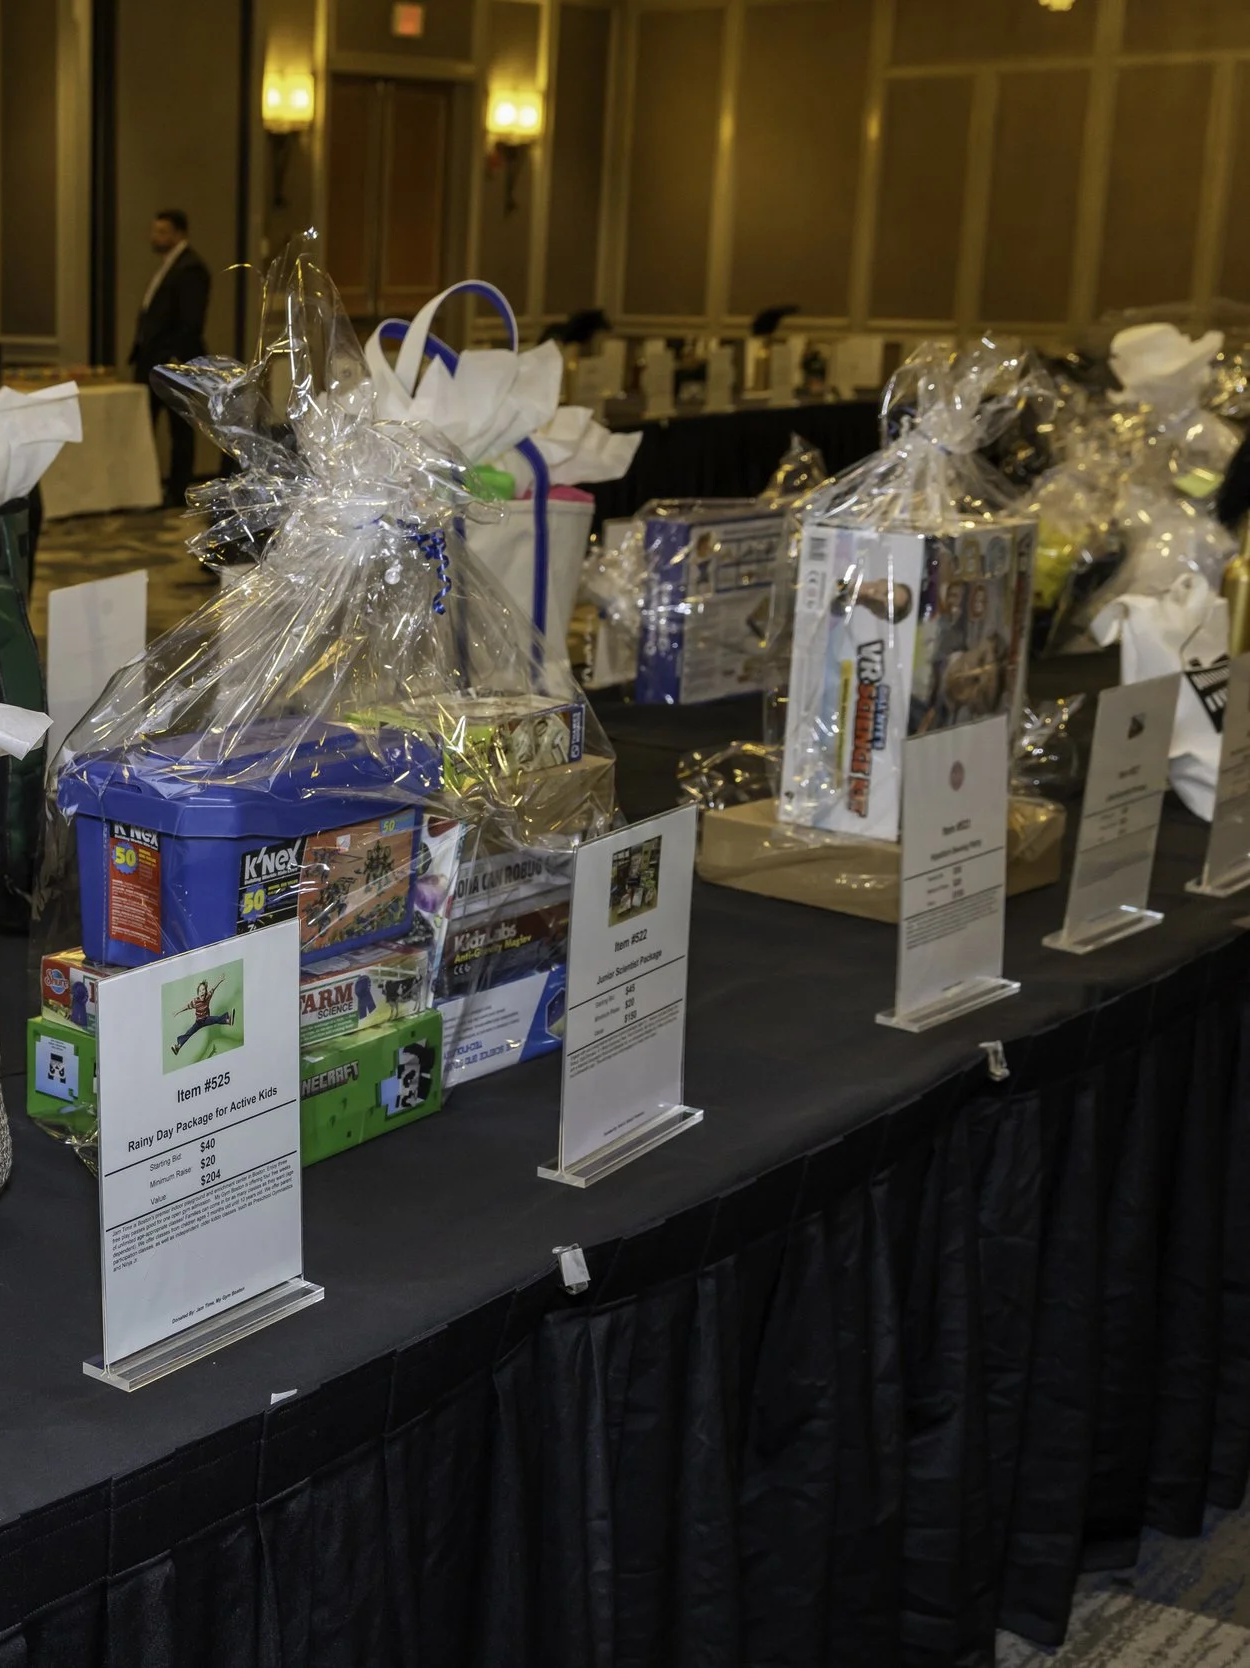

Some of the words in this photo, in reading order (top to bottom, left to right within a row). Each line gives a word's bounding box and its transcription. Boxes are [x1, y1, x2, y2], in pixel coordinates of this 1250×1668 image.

[858, 641, 885, 682] VR
[852, 683, 874, 775] SCIENCE
[848, 778, 870, 817] KIT
[383, 820, 395, 832] 50
[115, 847, 137, 867] 50
[242, 890, 265, 914] 50
[504, 934, 533, 950] Maglev
[614, 939, 629, 952] Item
[631, 929, 647, 944] #522
[596, 971, 615, 985] Junior
[615, 959, 639, 976] Scientist
[639, 950, 662, 965] Package
[625, 983, 635, 995] $45
[625, 997, 634, 1009] $20
[318, 1002, 354, 1020] SCIENCE
[177, 1085, 201, 1103] Item
[204, 1071, 230, 1093] #525
[302, 1060, 360, 1098] NECRAFT
[128, 1135, 154, 1152] Rainy
[156, 1128, 173, 1141] Day
[176, 1112, 213, 1133] Package
[215, 1106, 228, 1117] for
[230, 1095, 256, 1112] Active
[258, 1086, 277, 1101] Kids
[149, 1158, 171, 1171] Starting
[200, 1138, 215, 1153] $40
[150, 1173, 175, 1188] Minimum
[200, 1154, 215, 1169] $20
[201, 1169, 221, 1186] $204
